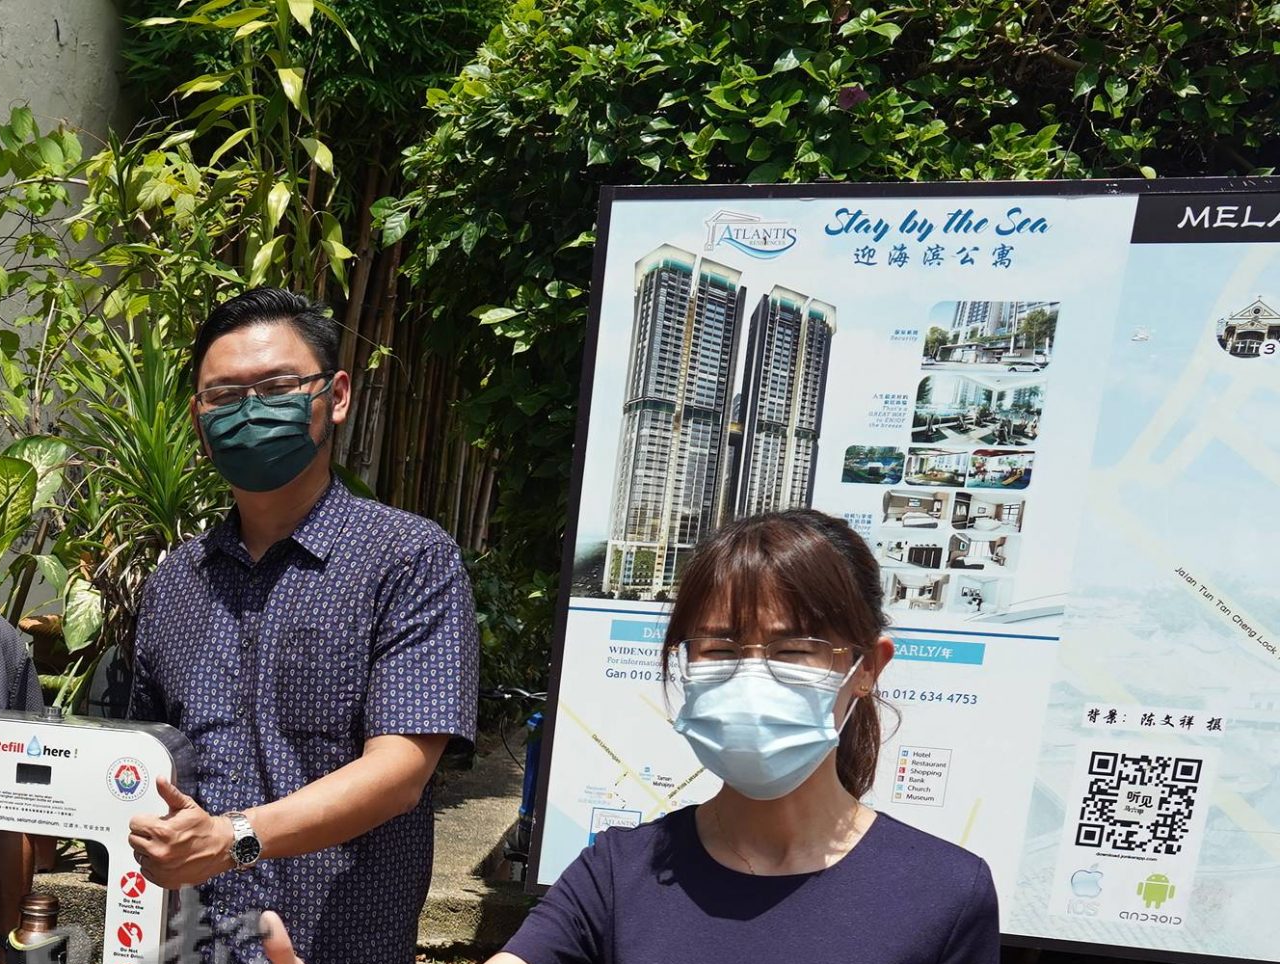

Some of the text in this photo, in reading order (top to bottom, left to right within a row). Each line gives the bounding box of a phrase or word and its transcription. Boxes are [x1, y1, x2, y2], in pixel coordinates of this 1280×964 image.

[825, 207, 1052, 243] Stay by the Sea
[716, 224, 797, 247] ATLANTIS
[853, 243, 1015, 269] 迎海滨公寓
[1263, 343, 1276, 355] 3
[1174, 566, 1278, 655] Jalan Tun Tan Cheng Lock
[893, 643, 954, 660] EARLY/年
[605, 668, 627, 679] Gan
[630, 669, 652, 681] 010
[892, 688, 916, 700] 012
[919, 690, 943, 702] 634
[946, 693, 978, 705] 4753
[911, 759, 947, 768] Restaurant
[910, 768, 943, 777] Shopping
[907, 784, 931, 792] Church
[905, 793, 935, 801] Museum
[1126, 790, 1154, 809] 听见
